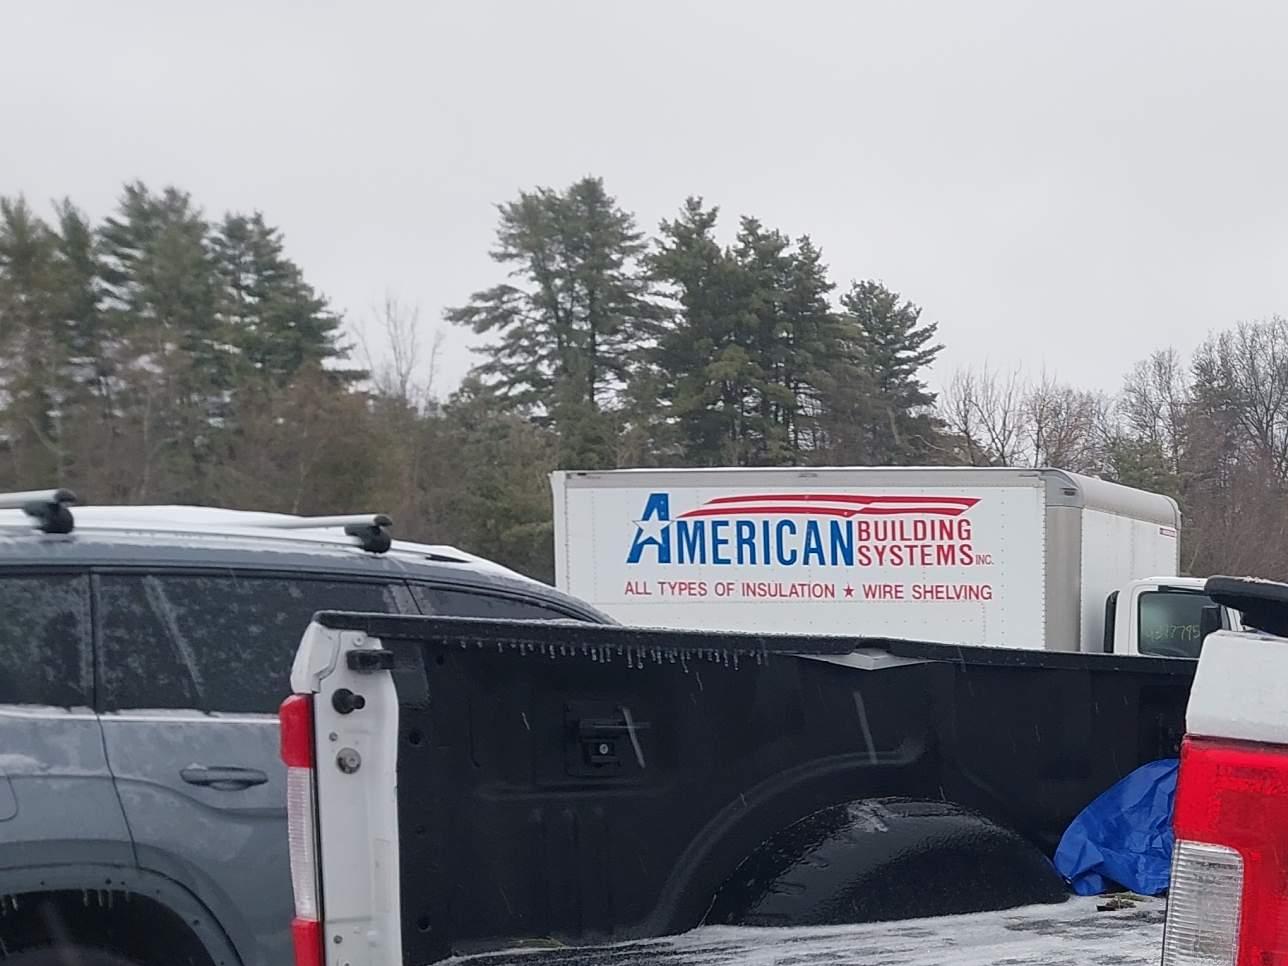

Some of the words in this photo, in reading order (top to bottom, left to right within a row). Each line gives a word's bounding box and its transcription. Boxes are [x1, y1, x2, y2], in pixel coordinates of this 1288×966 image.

[626, 493, 854, 567] AMERICAN
[858, 519, 971, 542] BUILDING
[858, 544, 974, 567] SYSTEMS
[976, 554, 994, 565] INC.
[625, 582, 652, 595] ALL
[658, 582, 708, 597] TYPES
[714, 582, 736, 597] OF
[742, 582, 835, 599] INSULATION
[863, 584, 904, 599] WIRE
[912, 585, 993, 600] SHELVING
